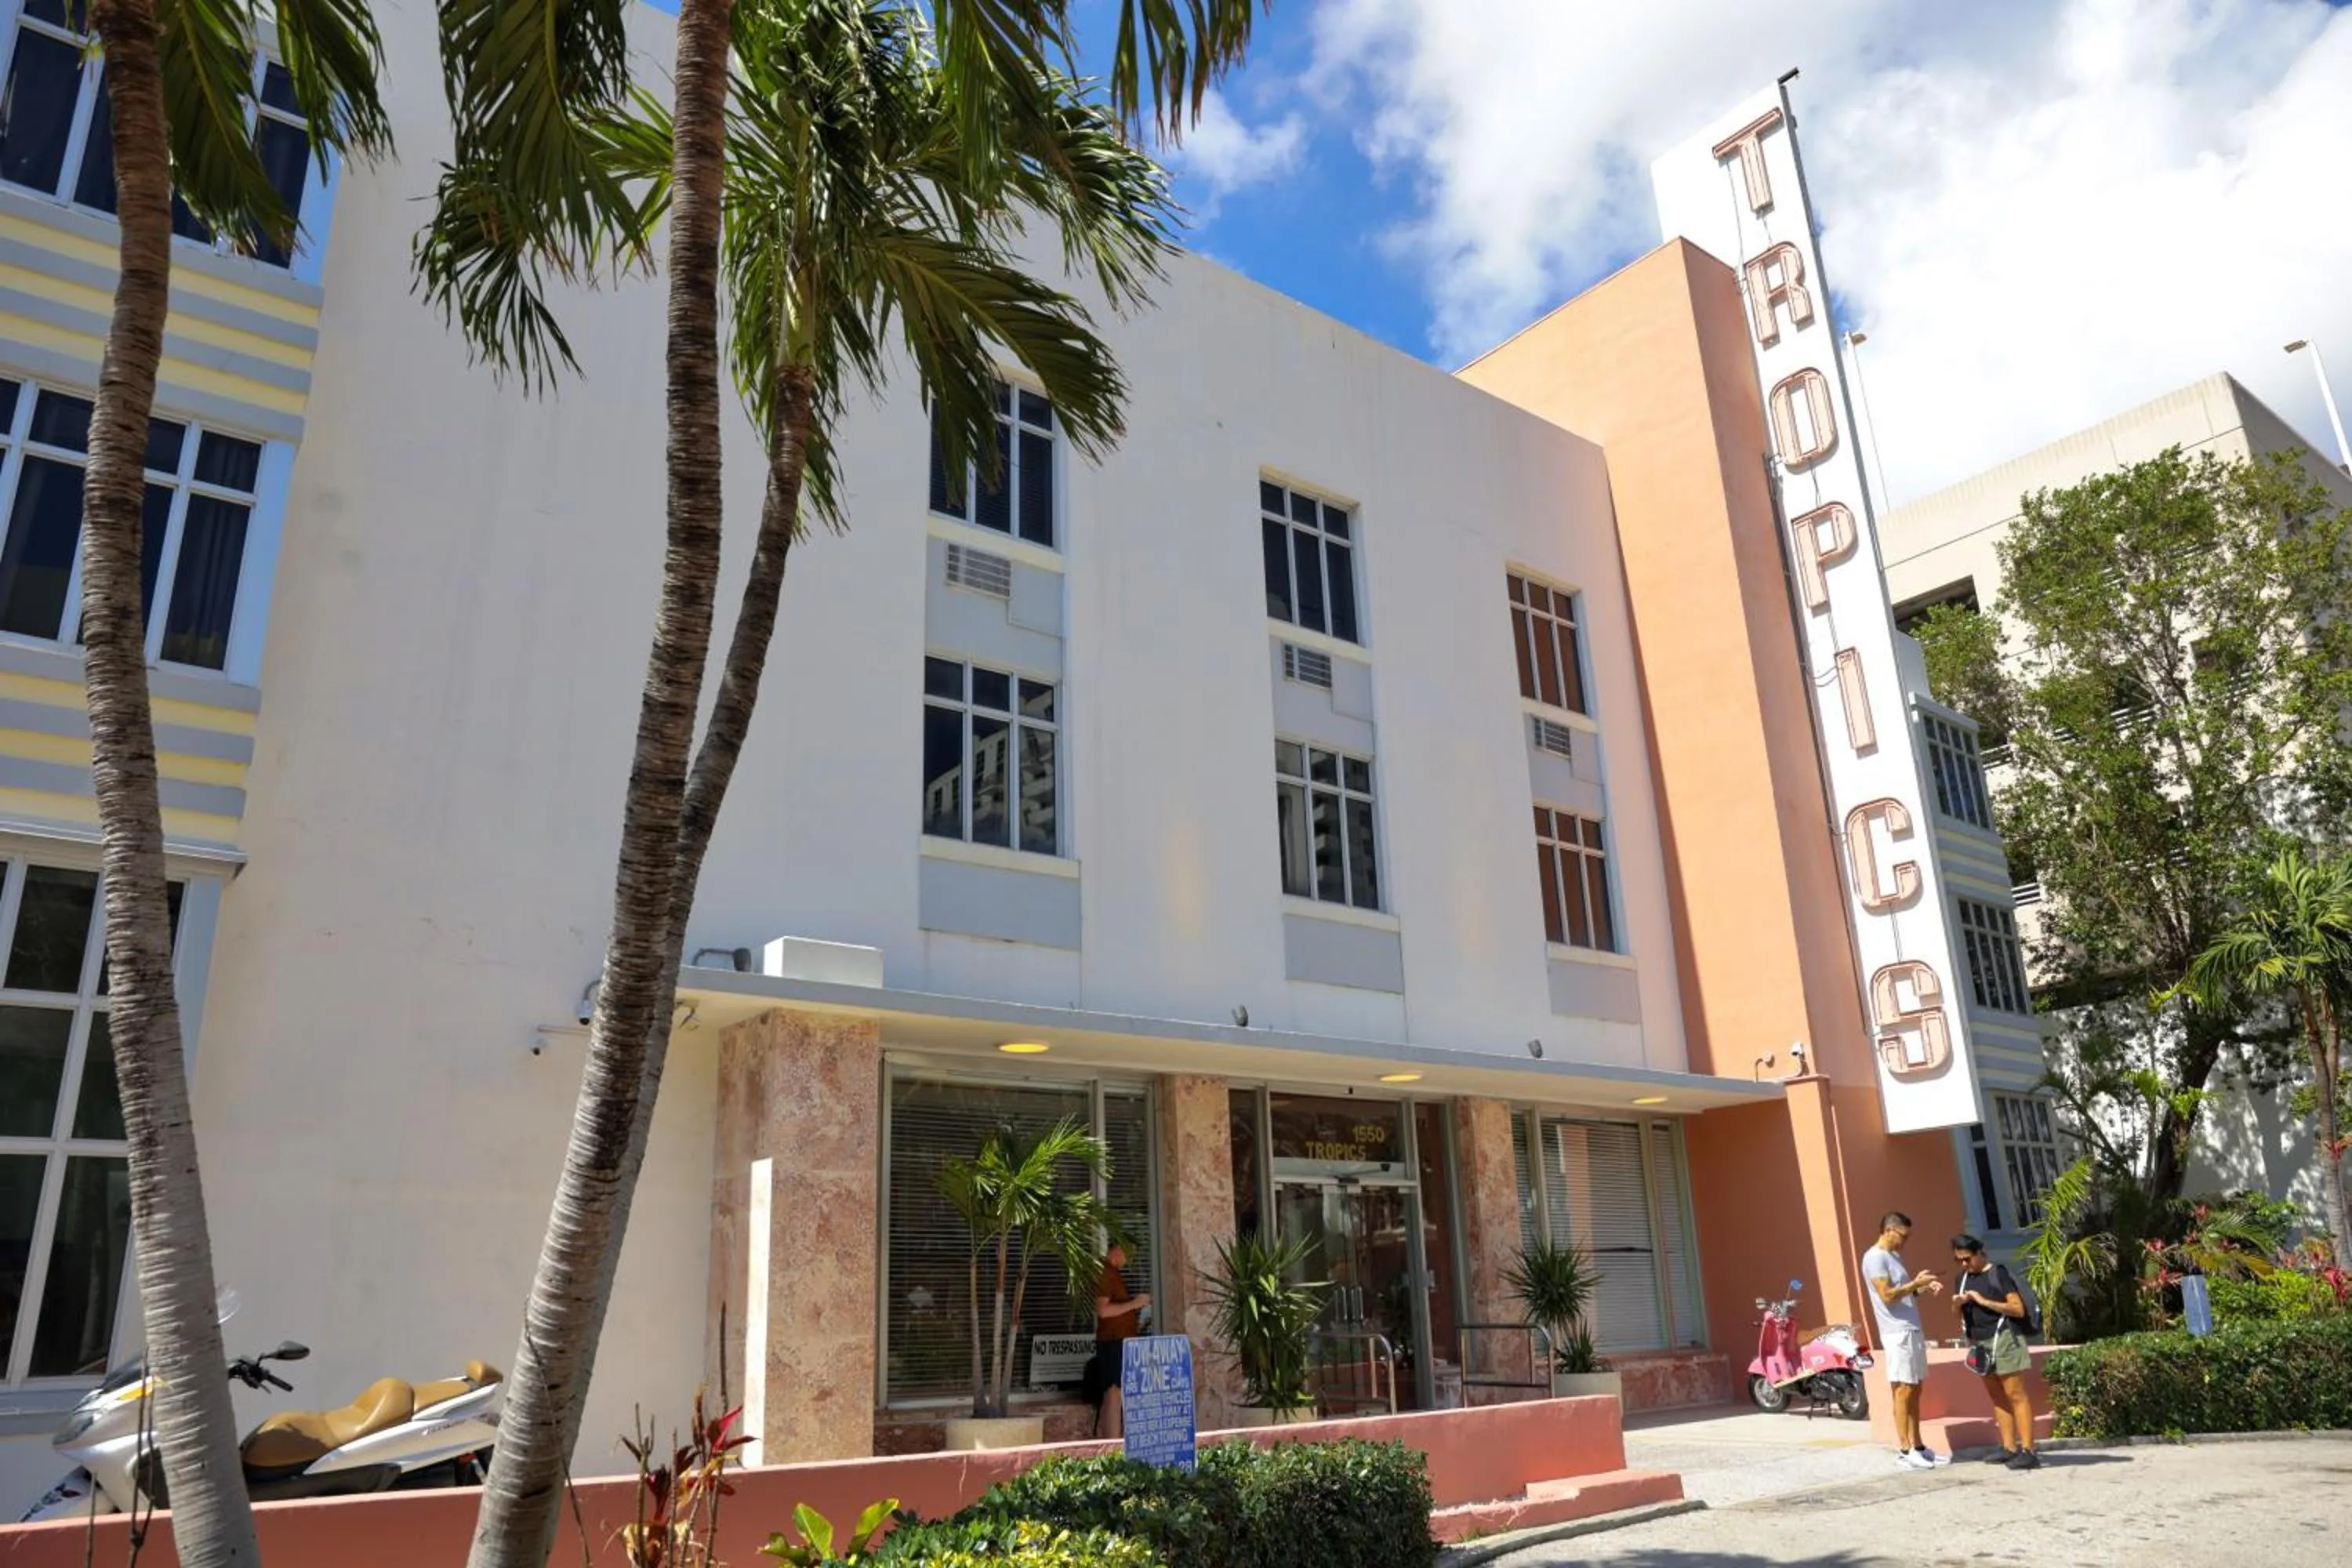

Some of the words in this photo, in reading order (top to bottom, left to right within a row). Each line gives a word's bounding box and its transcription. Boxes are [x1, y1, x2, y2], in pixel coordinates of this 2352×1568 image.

[1712, 105, 1953, 1076] TROPICS
[1352, 1125, 1385, 1143] 1550
[1305, 1141, 1367, 1160] TROPICS
[1034, 1341, 1047, 1356] NO
[1141, 1365, 1171, 1393] ZONE
